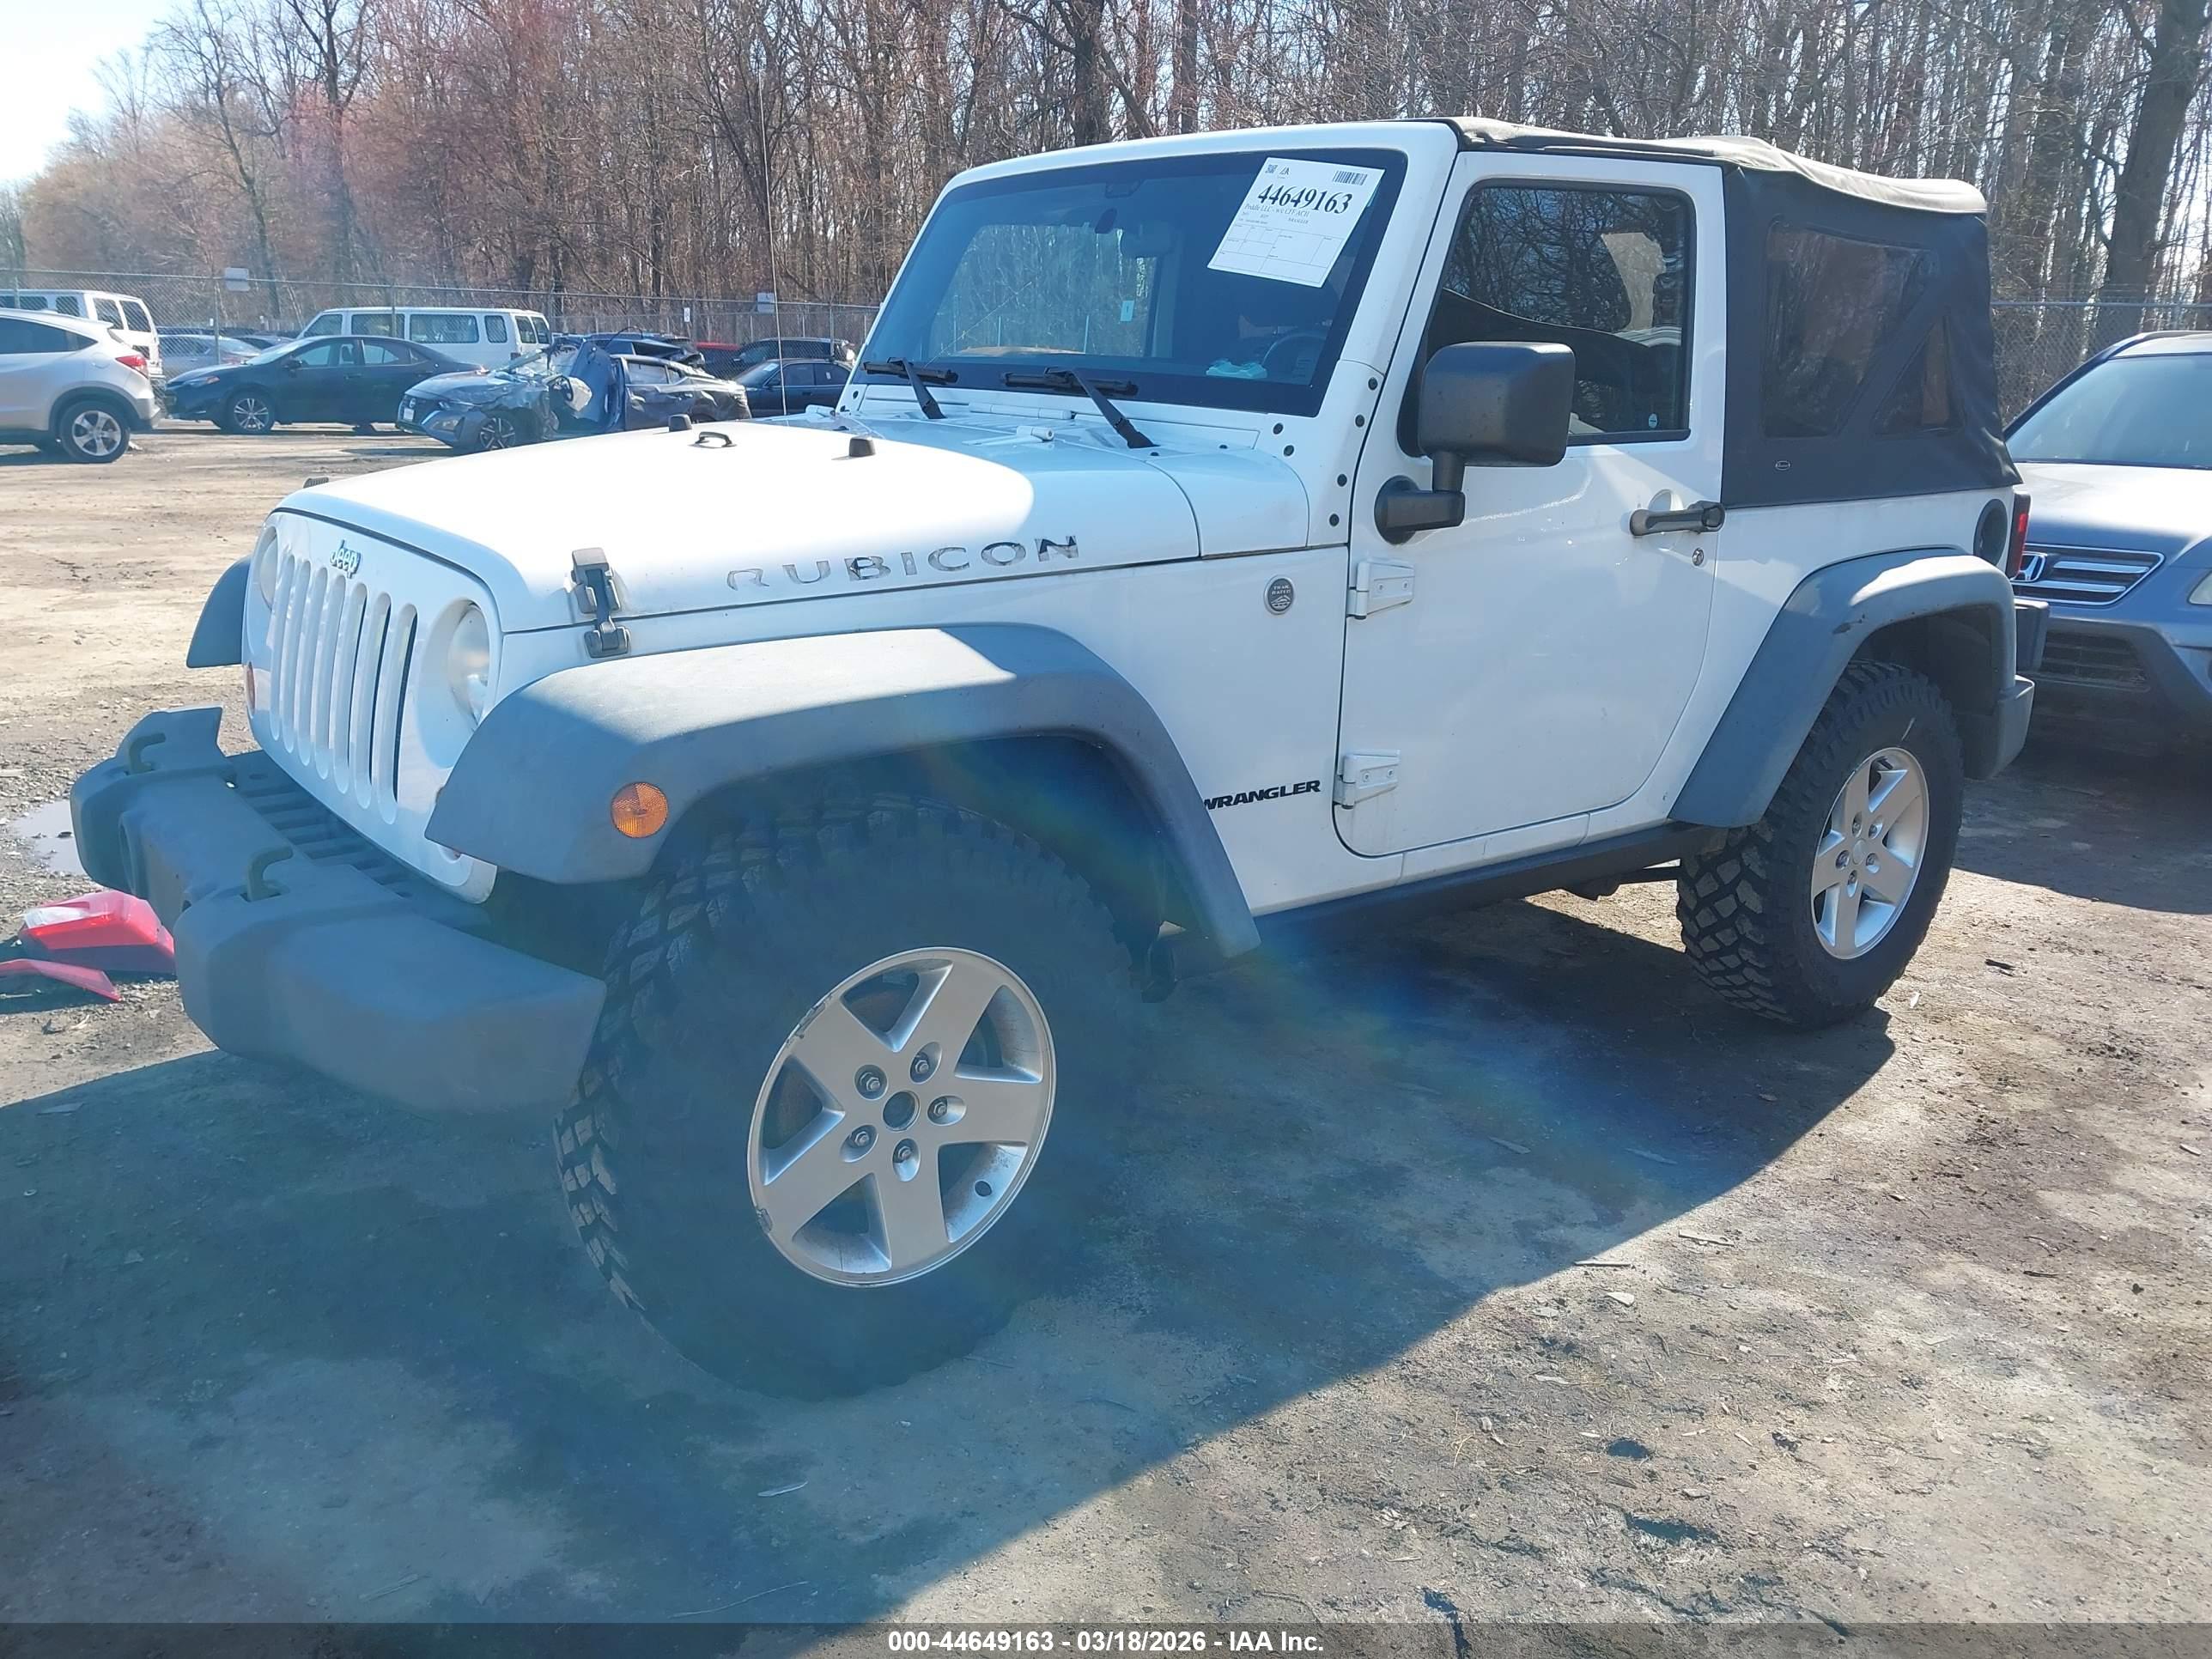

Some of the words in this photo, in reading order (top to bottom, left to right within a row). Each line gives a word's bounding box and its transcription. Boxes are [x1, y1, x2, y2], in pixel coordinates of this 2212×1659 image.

[1257, 183, 1353, 215] 44649163
[331, 539, 362, 580] Jeep
[726, 535, 1079, 591] RUBICON
[1204, 780, 1321, 811] WRANGLER
